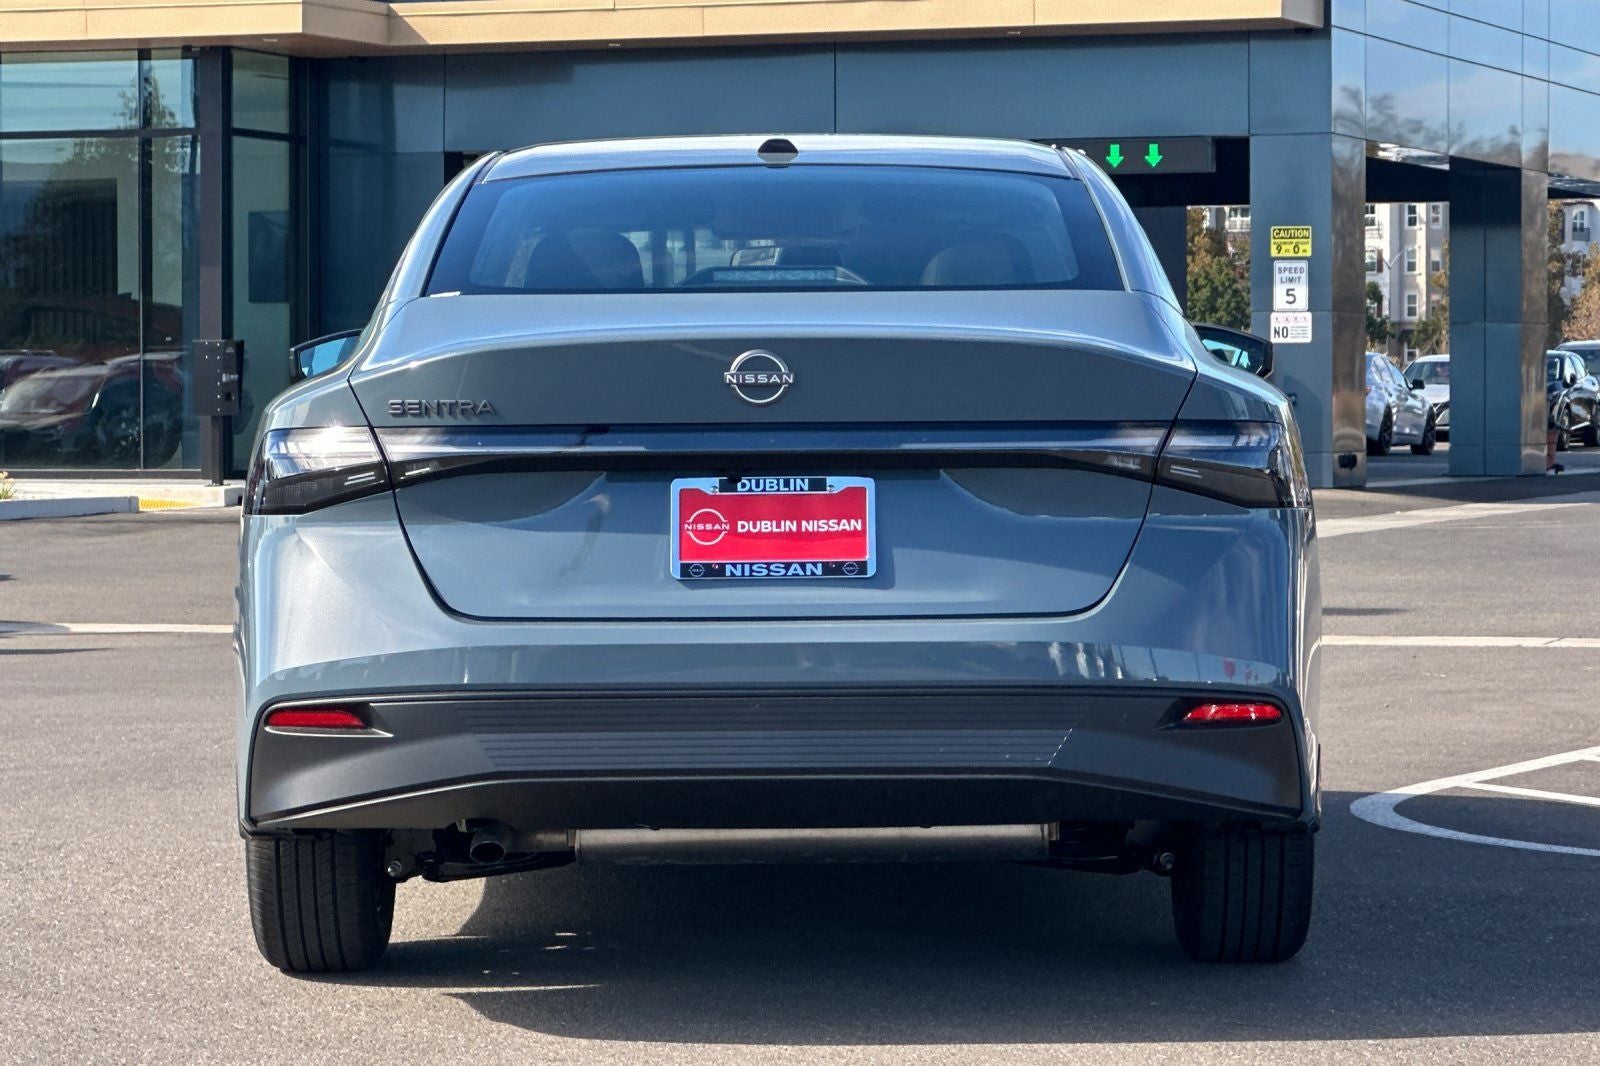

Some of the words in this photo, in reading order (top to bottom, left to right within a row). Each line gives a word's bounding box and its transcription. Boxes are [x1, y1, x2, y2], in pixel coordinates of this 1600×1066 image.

[1273, 229, 1309, 238] CAUTION
[1276, 244, 1282, 254] 9
[1293, 244, 1300, 254] 0
[1285, 288, 1296, 304] 5
[1273, 326, 1288, 338] NO
[725, 374, 794, 383] NISSAN
[388, 399, 497, 417] SENTRA
[737, 478, 809, 492] DUBLIN
[684, 523, 730, 531] NISSAN
[737, 520, 797, 533] DUBLIN
[801, 519, 862, 532] NISSAN
[725, 562, 823, 577] NISSAN
